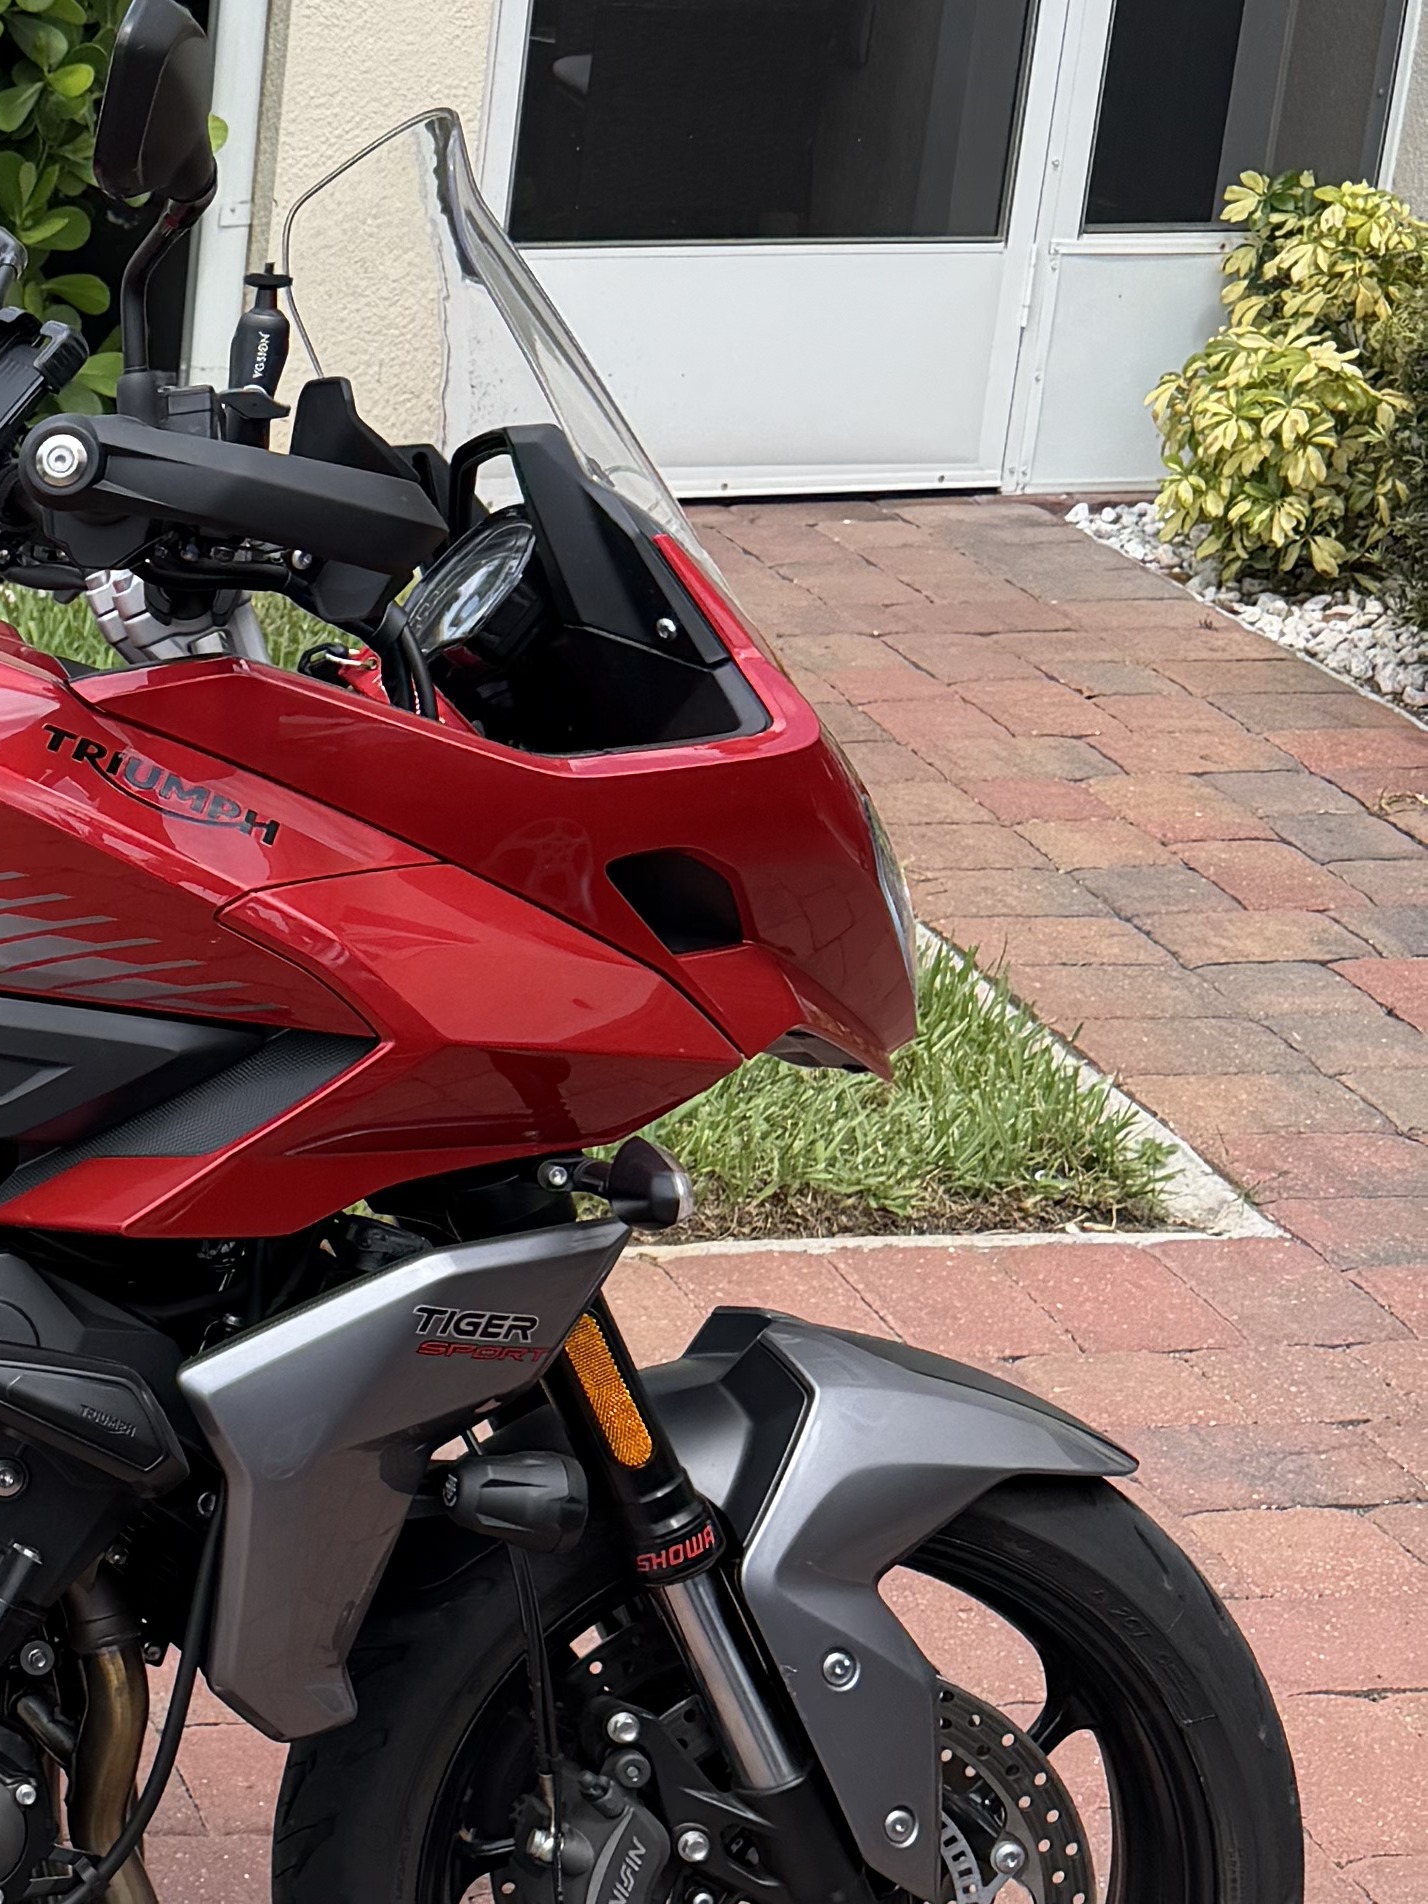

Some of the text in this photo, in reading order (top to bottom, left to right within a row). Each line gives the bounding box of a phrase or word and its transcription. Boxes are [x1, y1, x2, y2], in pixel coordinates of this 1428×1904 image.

[42, 723, 281, 848] TRIUMPH
[412, 1304, 539, 1343] TIGER
[416, 1339, 549, 1363] SPORT
[80, 1403, 137, 1438] TRIUMPH
[636, 1524, 715, 1572] SHOWA
